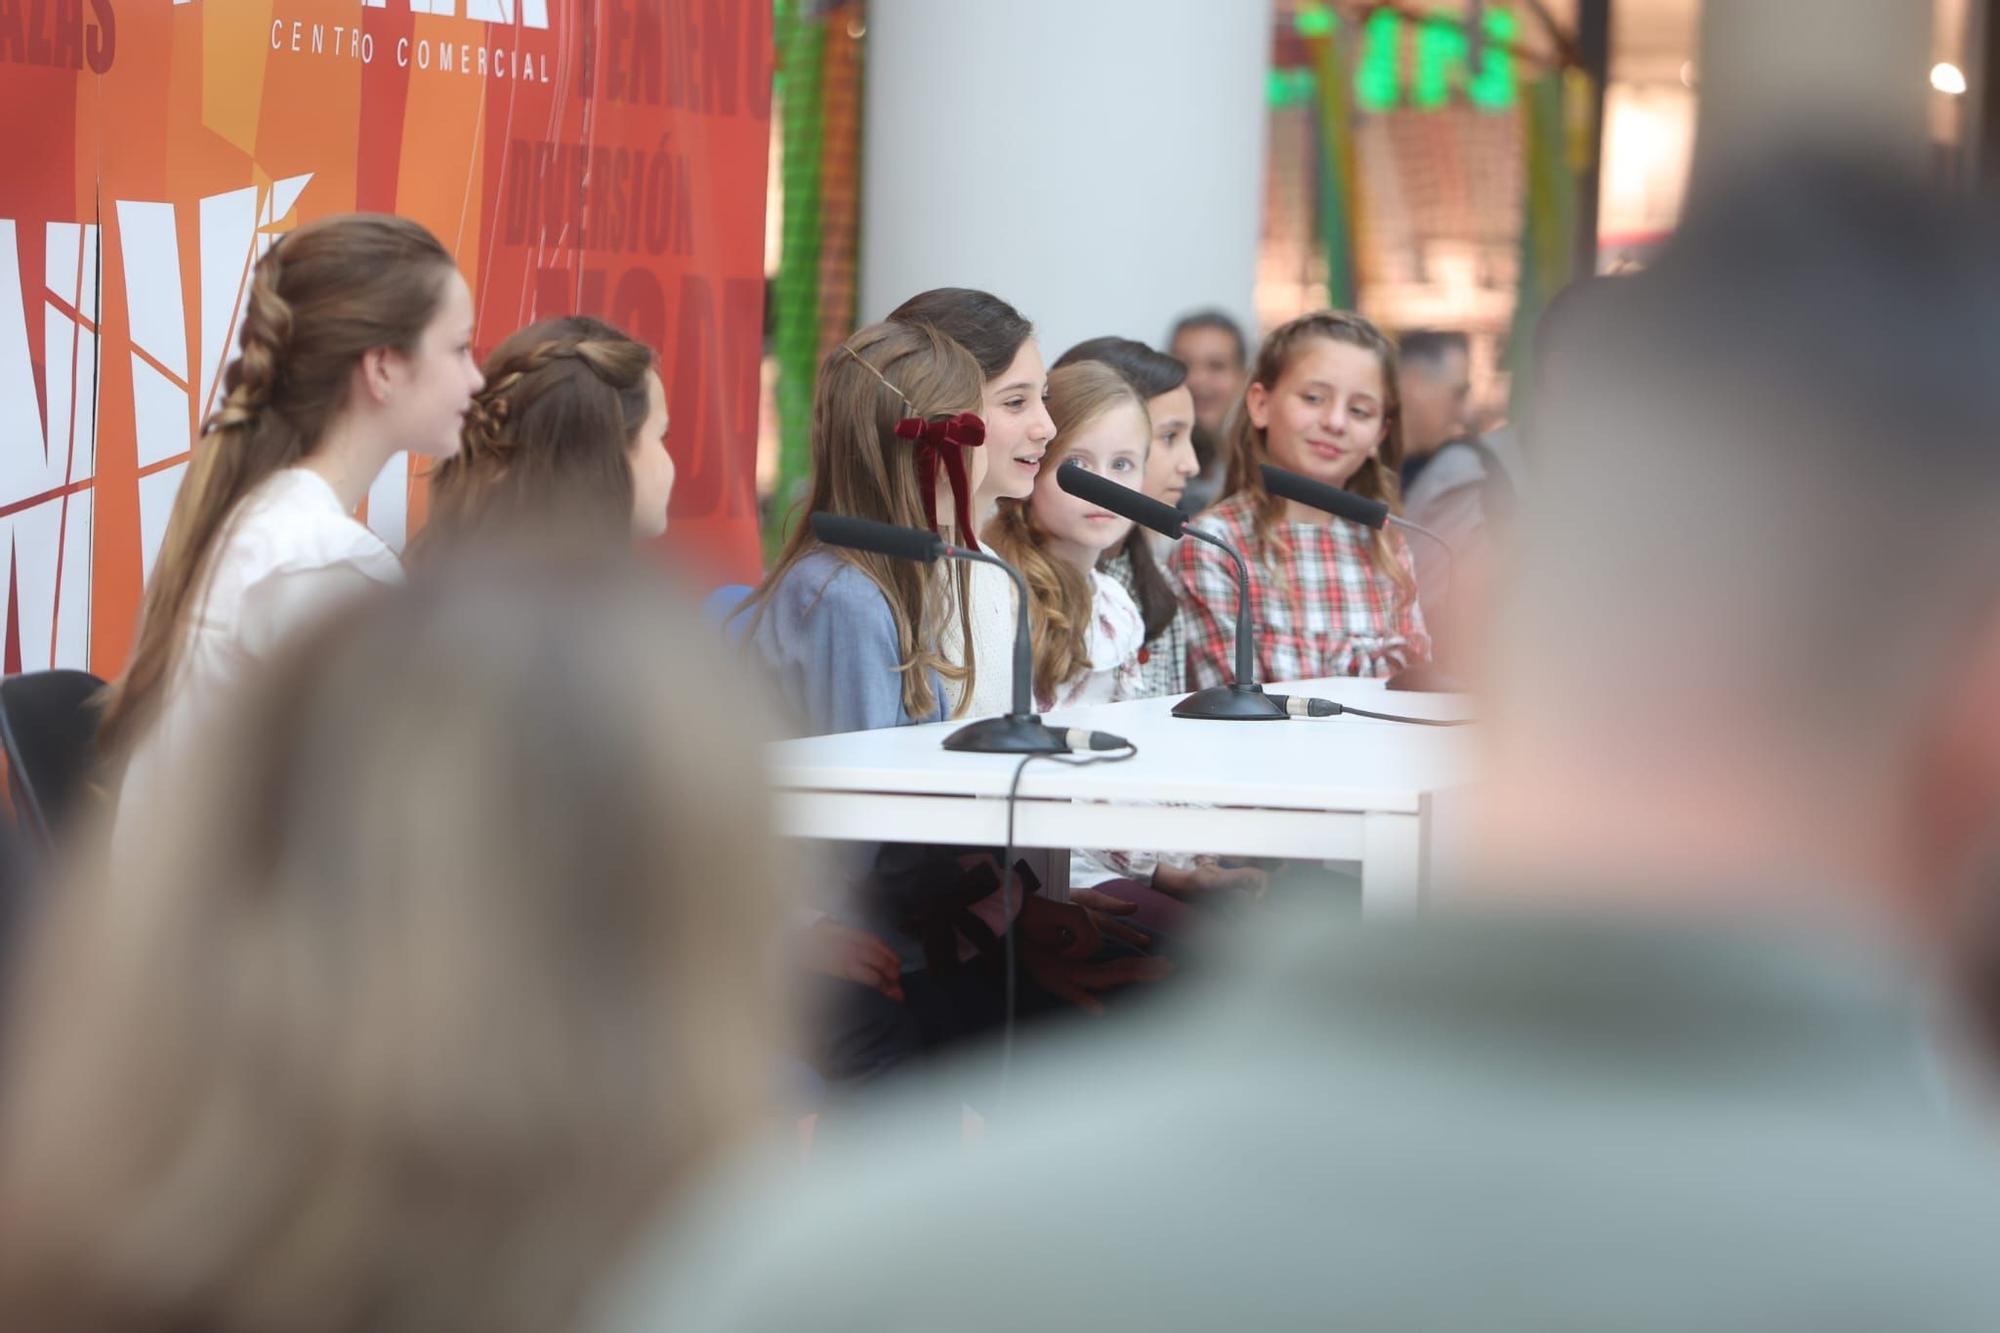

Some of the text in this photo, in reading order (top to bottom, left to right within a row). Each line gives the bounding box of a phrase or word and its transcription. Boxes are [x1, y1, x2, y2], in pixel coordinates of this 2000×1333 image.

[271, 19, 549, 82] CENTRO COMERCIAL
[504, 131, 694, 256] DIVERSIÓN
